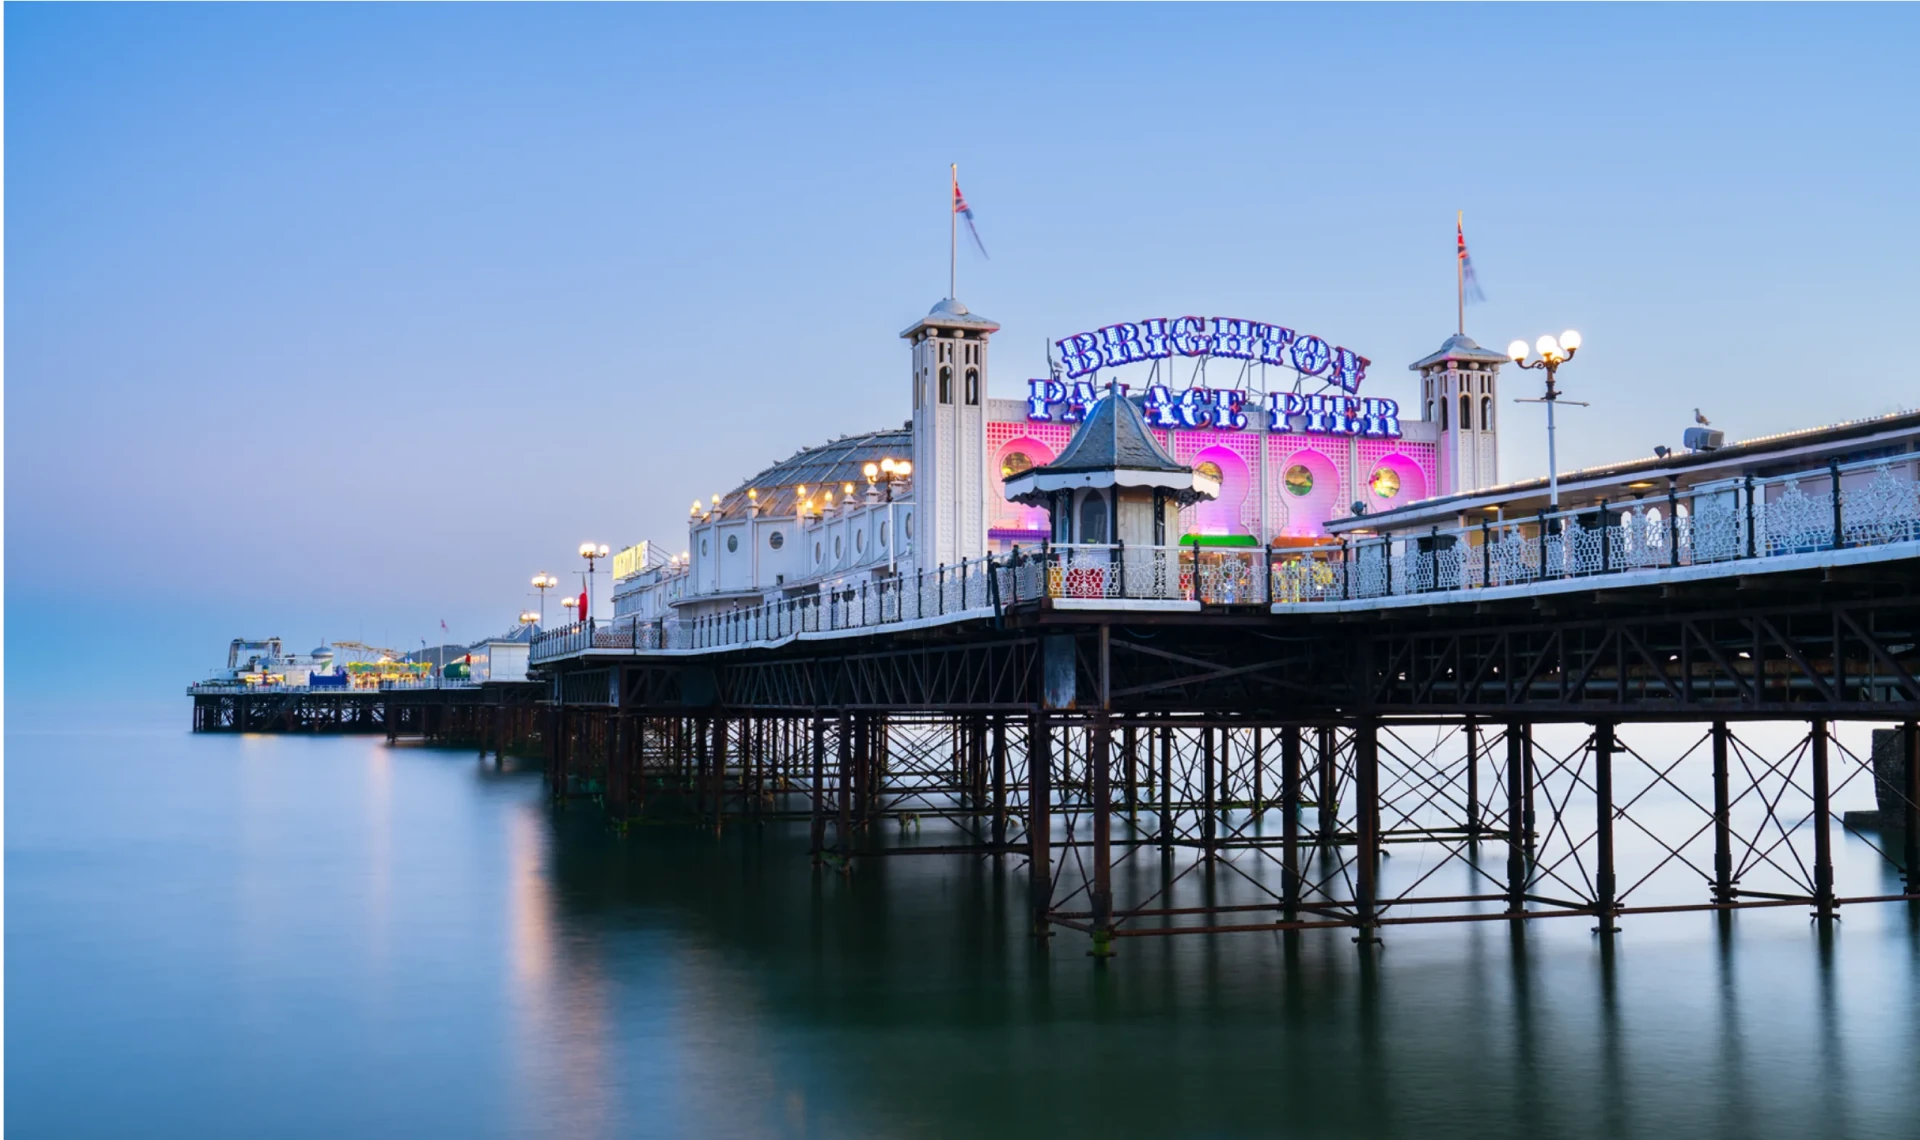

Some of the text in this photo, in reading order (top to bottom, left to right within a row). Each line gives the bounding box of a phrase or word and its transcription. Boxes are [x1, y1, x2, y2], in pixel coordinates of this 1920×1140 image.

[1055, 316, 1371, 393] BRIGHTON
[1027, 378, 1403, 440] PAACE PIER
